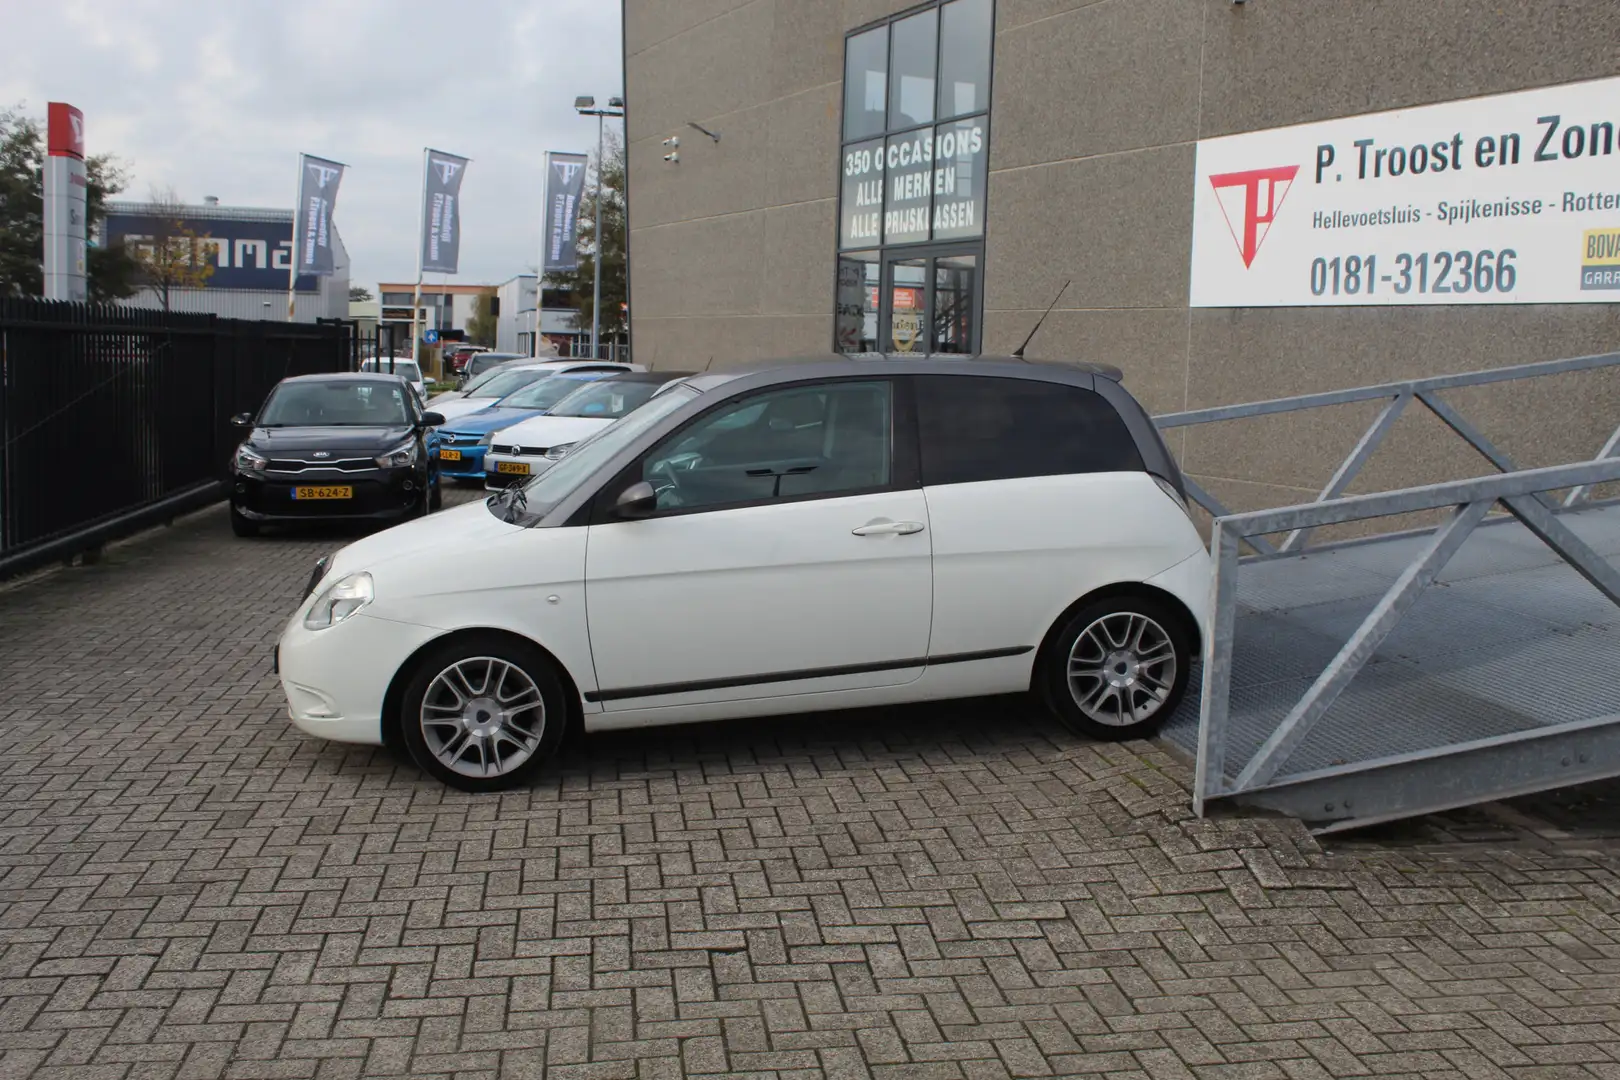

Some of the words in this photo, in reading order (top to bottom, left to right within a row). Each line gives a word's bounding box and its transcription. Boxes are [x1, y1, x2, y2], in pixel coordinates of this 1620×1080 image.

[845, 150, 871, 176] 350
[874, 127, 982, 170] OCCASIONS
[1315, 143, 1342, 184] P.
[1353, 131, 1463, 180] Troost
[1475, 131, 1522, 168] en
[1534, 114, 1620, 163] Zon
[856, 180, 882, 207] ALLE
[894, 167, 955, 201] MERKEN
[851, 213, 879, 239] ALLE
[1312, 205, 1421, 230] Hellevoetsluis
[1437, 196, 1543, 226] Spijkenisse
[1310, 249, 1518, 297] 0181-312366
[300, 487, 349, 498] SB-624-Z
